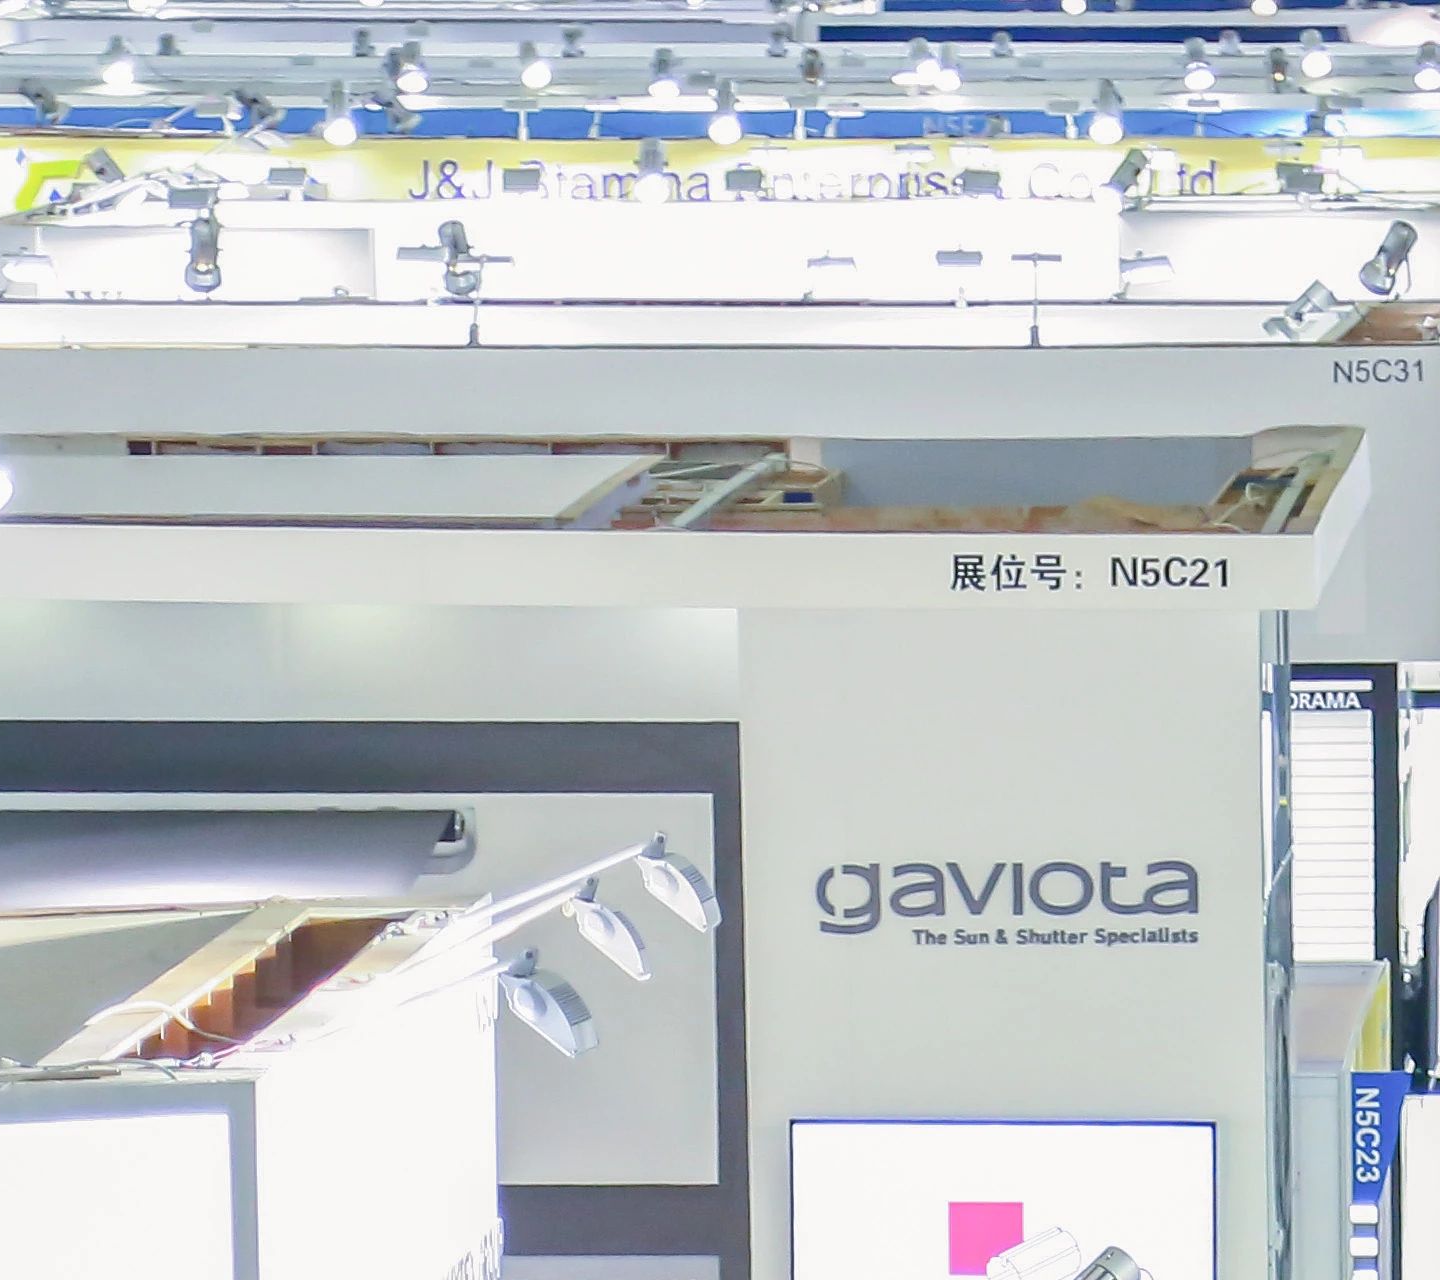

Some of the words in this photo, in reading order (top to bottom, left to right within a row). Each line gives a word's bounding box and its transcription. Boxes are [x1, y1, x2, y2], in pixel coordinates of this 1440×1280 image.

[409, 158, 495, 200] J&J
[1332, 360, 1425, 384] N5C31
[1109, 556, 1230, 589] N5C21
[814, 859, 1200, 935] gaviota
[912, 929, 947, 945] The
[953, 929, 990, 945] Sun
[994, 929, 1009, 945] &
[1016, 929, 1088, 945] Shutter
[1095, 927, 1199, 946] Specialists
[1355, 1087, 1380, 1184] N5C23
